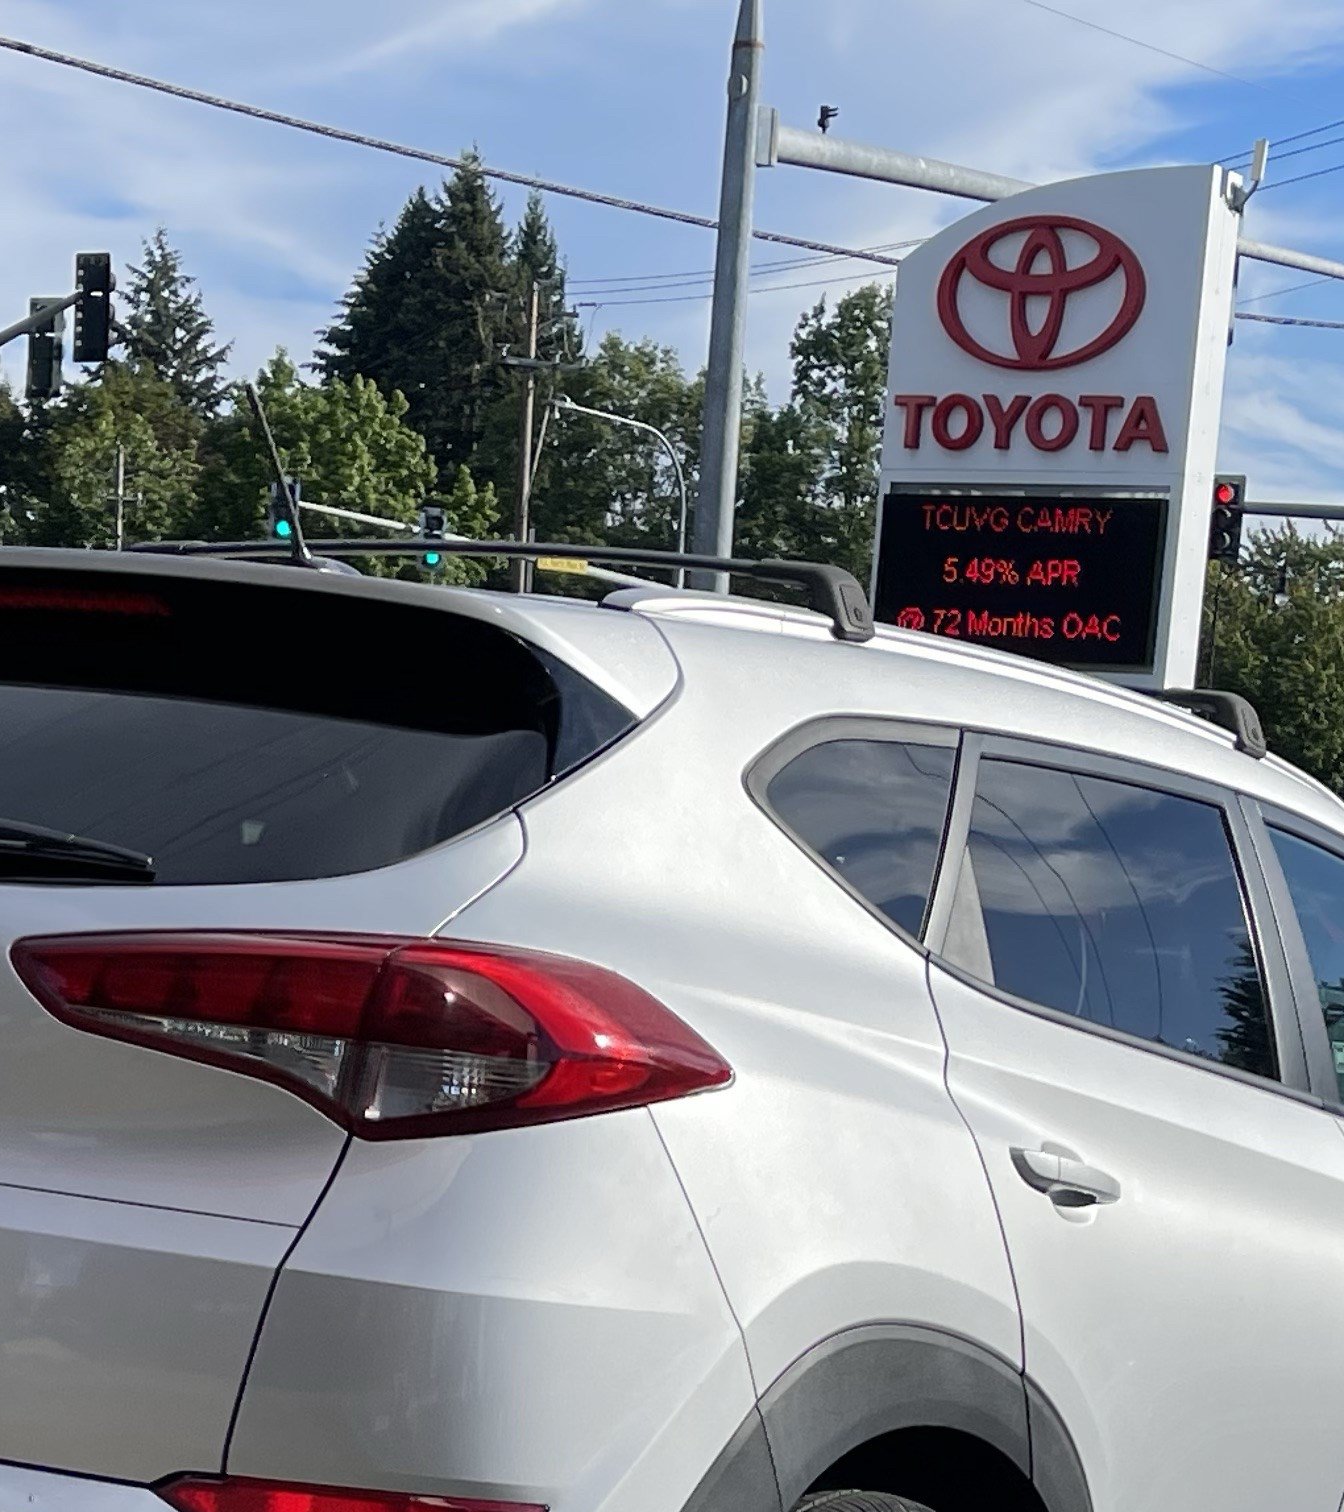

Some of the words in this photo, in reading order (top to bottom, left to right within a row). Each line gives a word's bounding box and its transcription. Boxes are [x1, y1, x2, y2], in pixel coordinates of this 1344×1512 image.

[894, 393, 1169, 453] TOYOTA
[1017, 506, 1114, 534] CAMRY
[943, 556, 1020, 586] 5.49%
[1026, 559, 1082, 587] APR
[932, 609, 962, 637] 72
[967, 608, 1055, 639] Months
[1062, 612, 1121, 642] OAC
